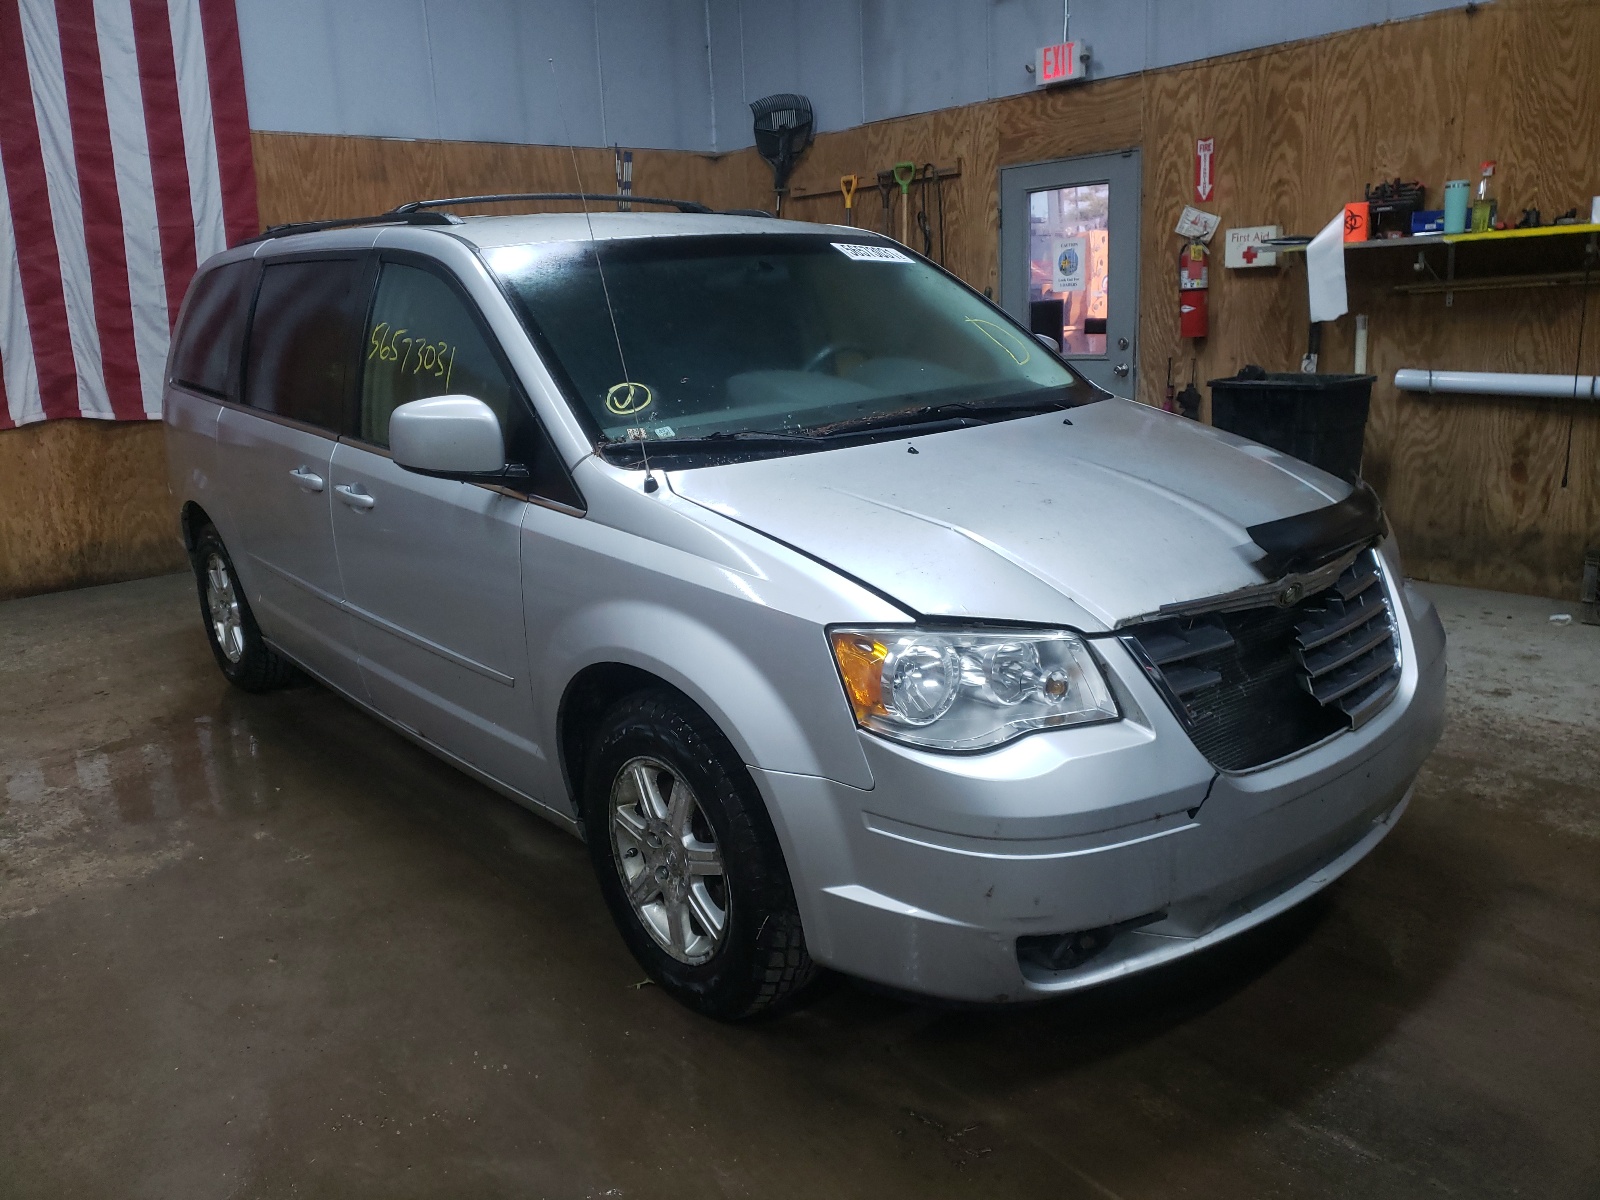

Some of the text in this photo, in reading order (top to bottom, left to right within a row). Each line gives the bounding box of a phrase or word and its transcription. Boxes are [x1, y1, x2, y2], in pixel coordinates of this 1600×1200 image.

[1043, 42, 1075, 80] EXIT
[1199, 143, 1212, 152] FIRE
[1231, 231, 1270, 242] First Aid
